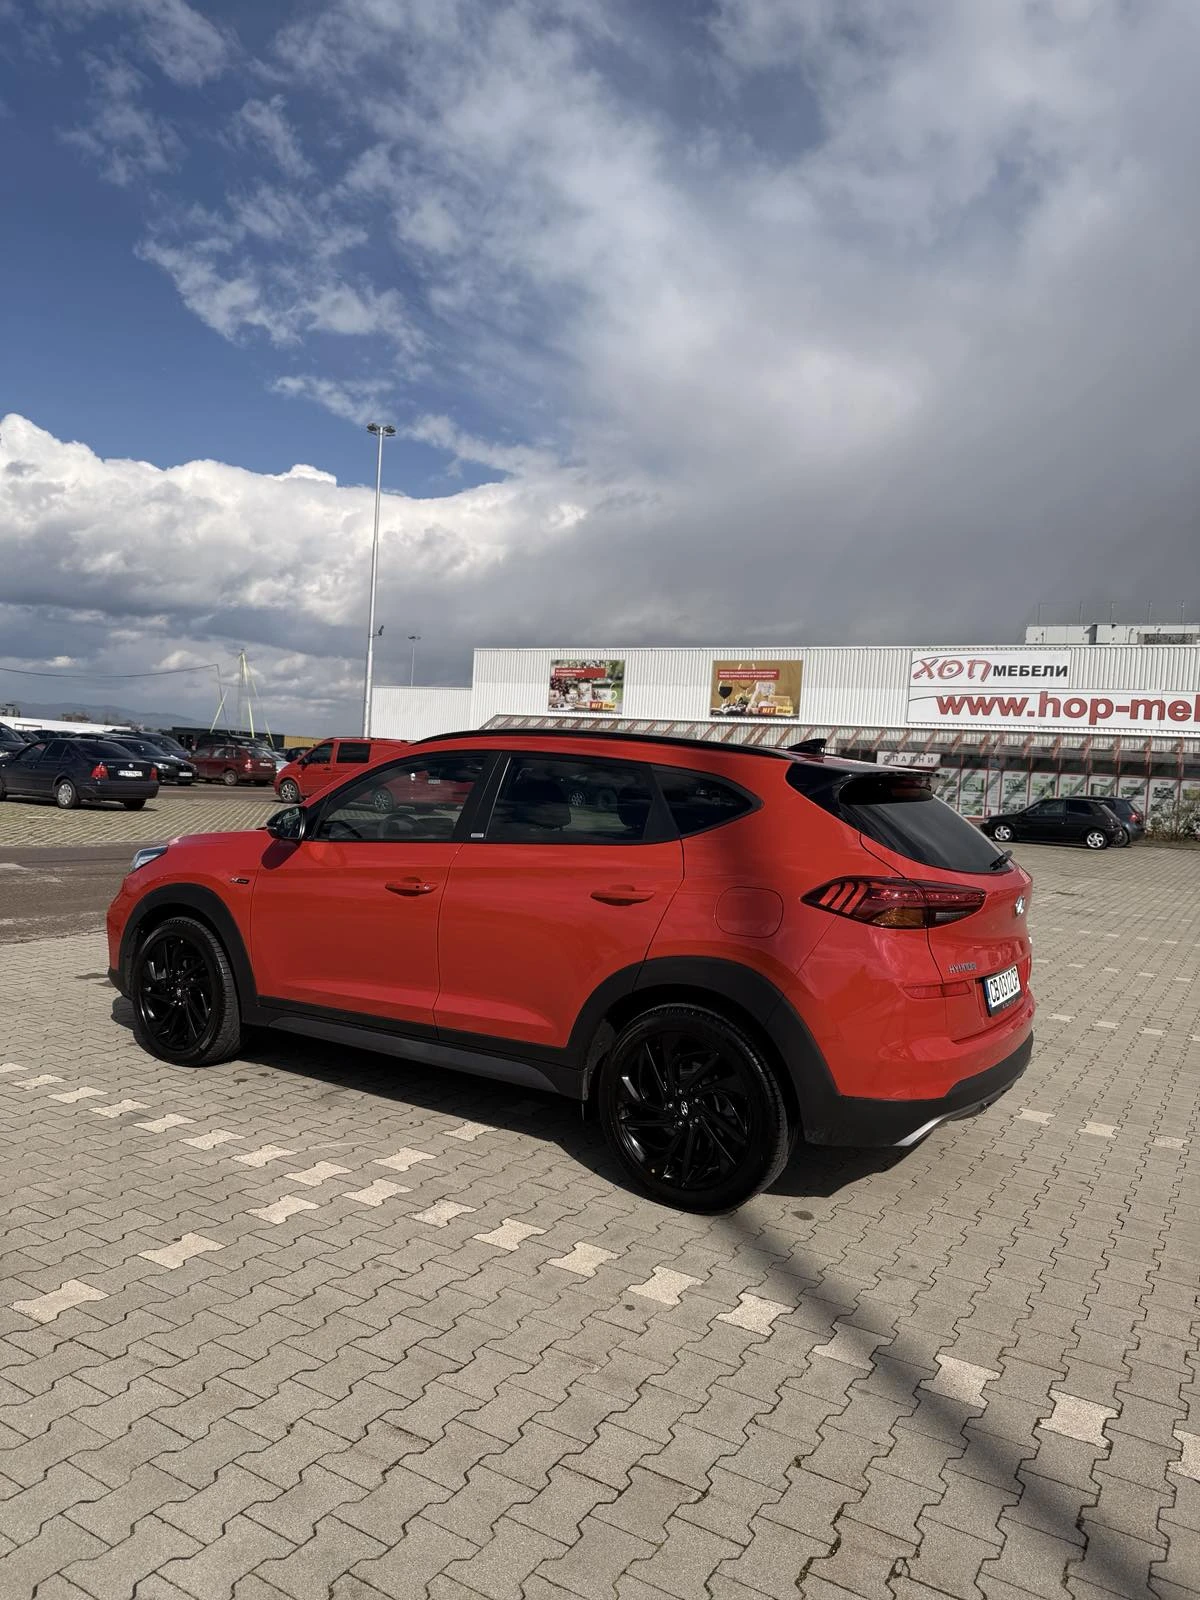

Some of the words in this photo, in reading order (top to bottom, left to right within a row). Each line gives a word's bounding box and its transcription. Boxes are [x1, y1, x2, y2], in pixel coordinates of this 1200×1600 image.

[912, 659, 992, 683] ХОП
[992, 664, 1068, 678] МЕБЕЛИ
[936, 691, 1200, 726] www.hop-me
